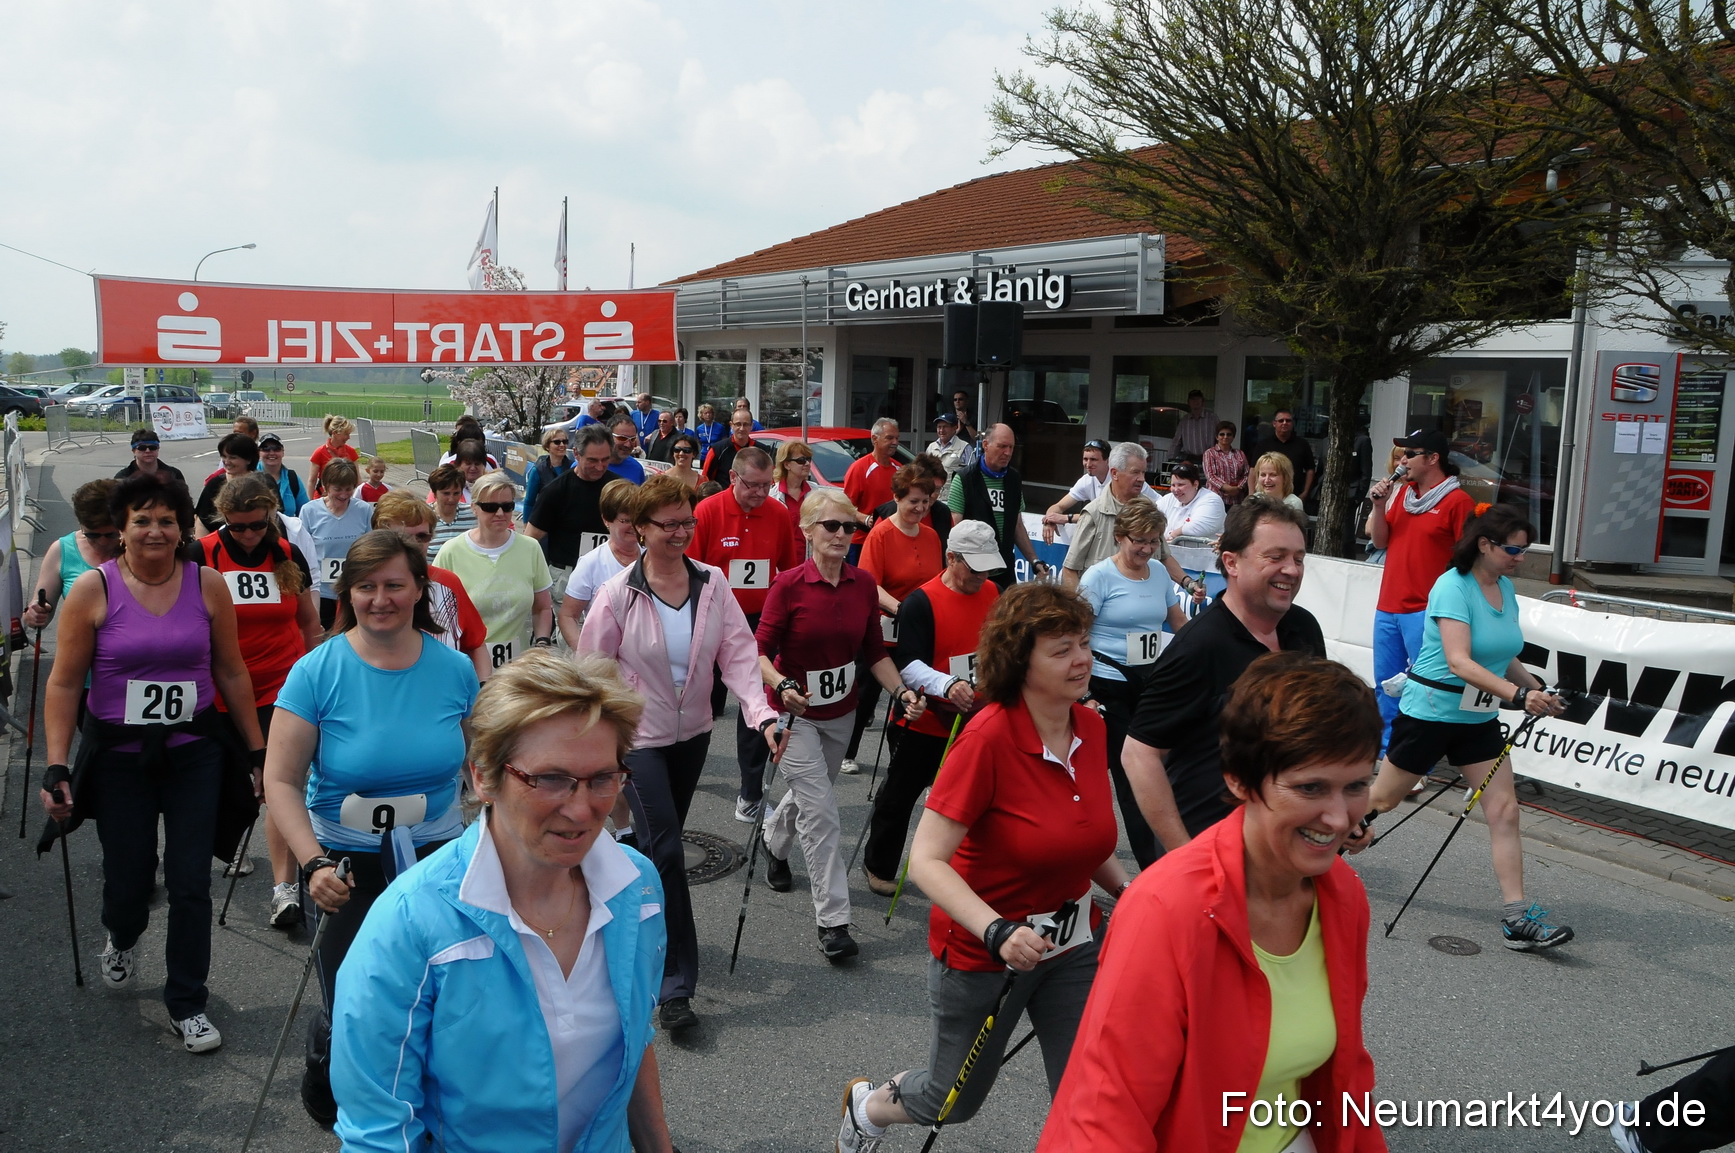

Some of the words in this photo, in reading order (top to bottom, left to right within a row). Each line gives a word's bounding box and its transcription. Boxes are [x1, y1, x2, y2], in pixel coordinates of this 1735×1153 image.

[845, 279, 946, 312] Gerhart
[953, 275, 973, 304] &
[982, 267, 1066, 310] Jänig
[1601, 412, 1665, 423] SEAT
[236, 572, 270, 599] 83
[743, 561, 756, 585] 2
[491, 641, 513, 669] 81
[1139, 632, 1158, 660] 16
[819, 666, 847, 699] 84
[141, 683, 184, 721] 26
[1500, 716, 1645, 777] adtwerke
[371, 803, 396, 835] 9
